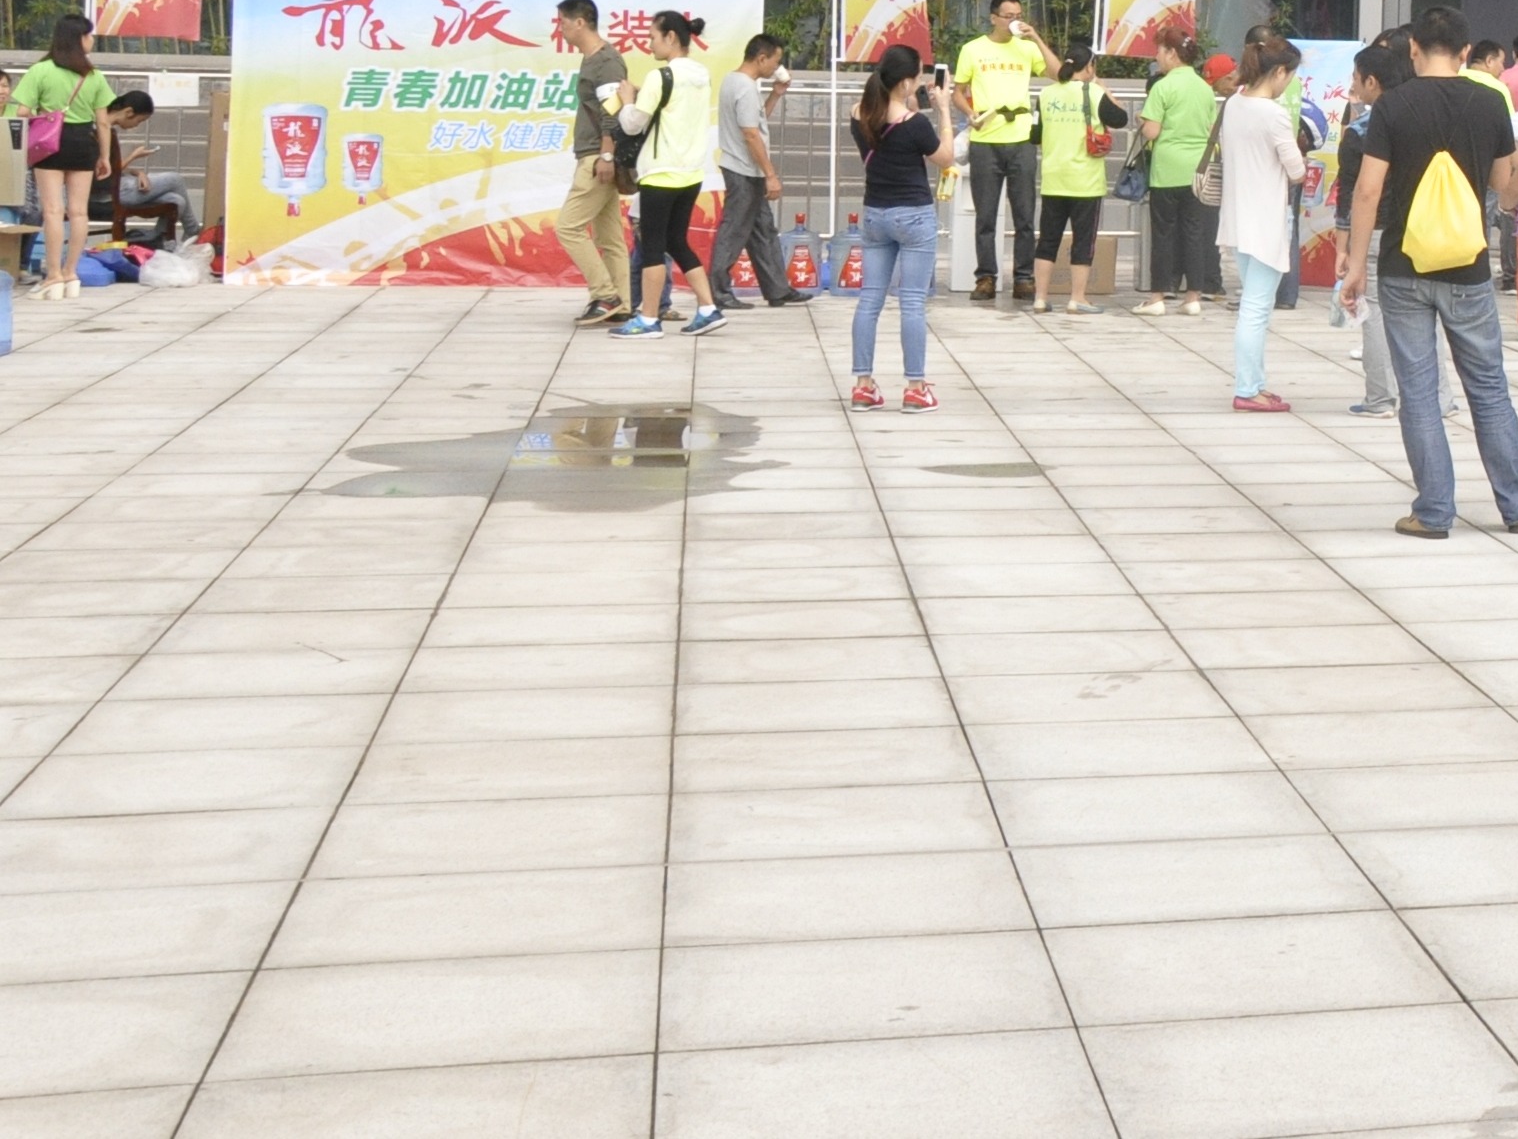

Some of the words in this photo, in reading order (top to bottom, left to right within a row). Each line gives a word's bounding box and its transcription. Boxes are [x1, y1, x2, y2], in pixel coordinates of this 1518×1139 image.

[343, 68, 580, 111] 青春加油站
[429, 121, 496, 151] 好水
[502, 122, 567, 152] 健康
